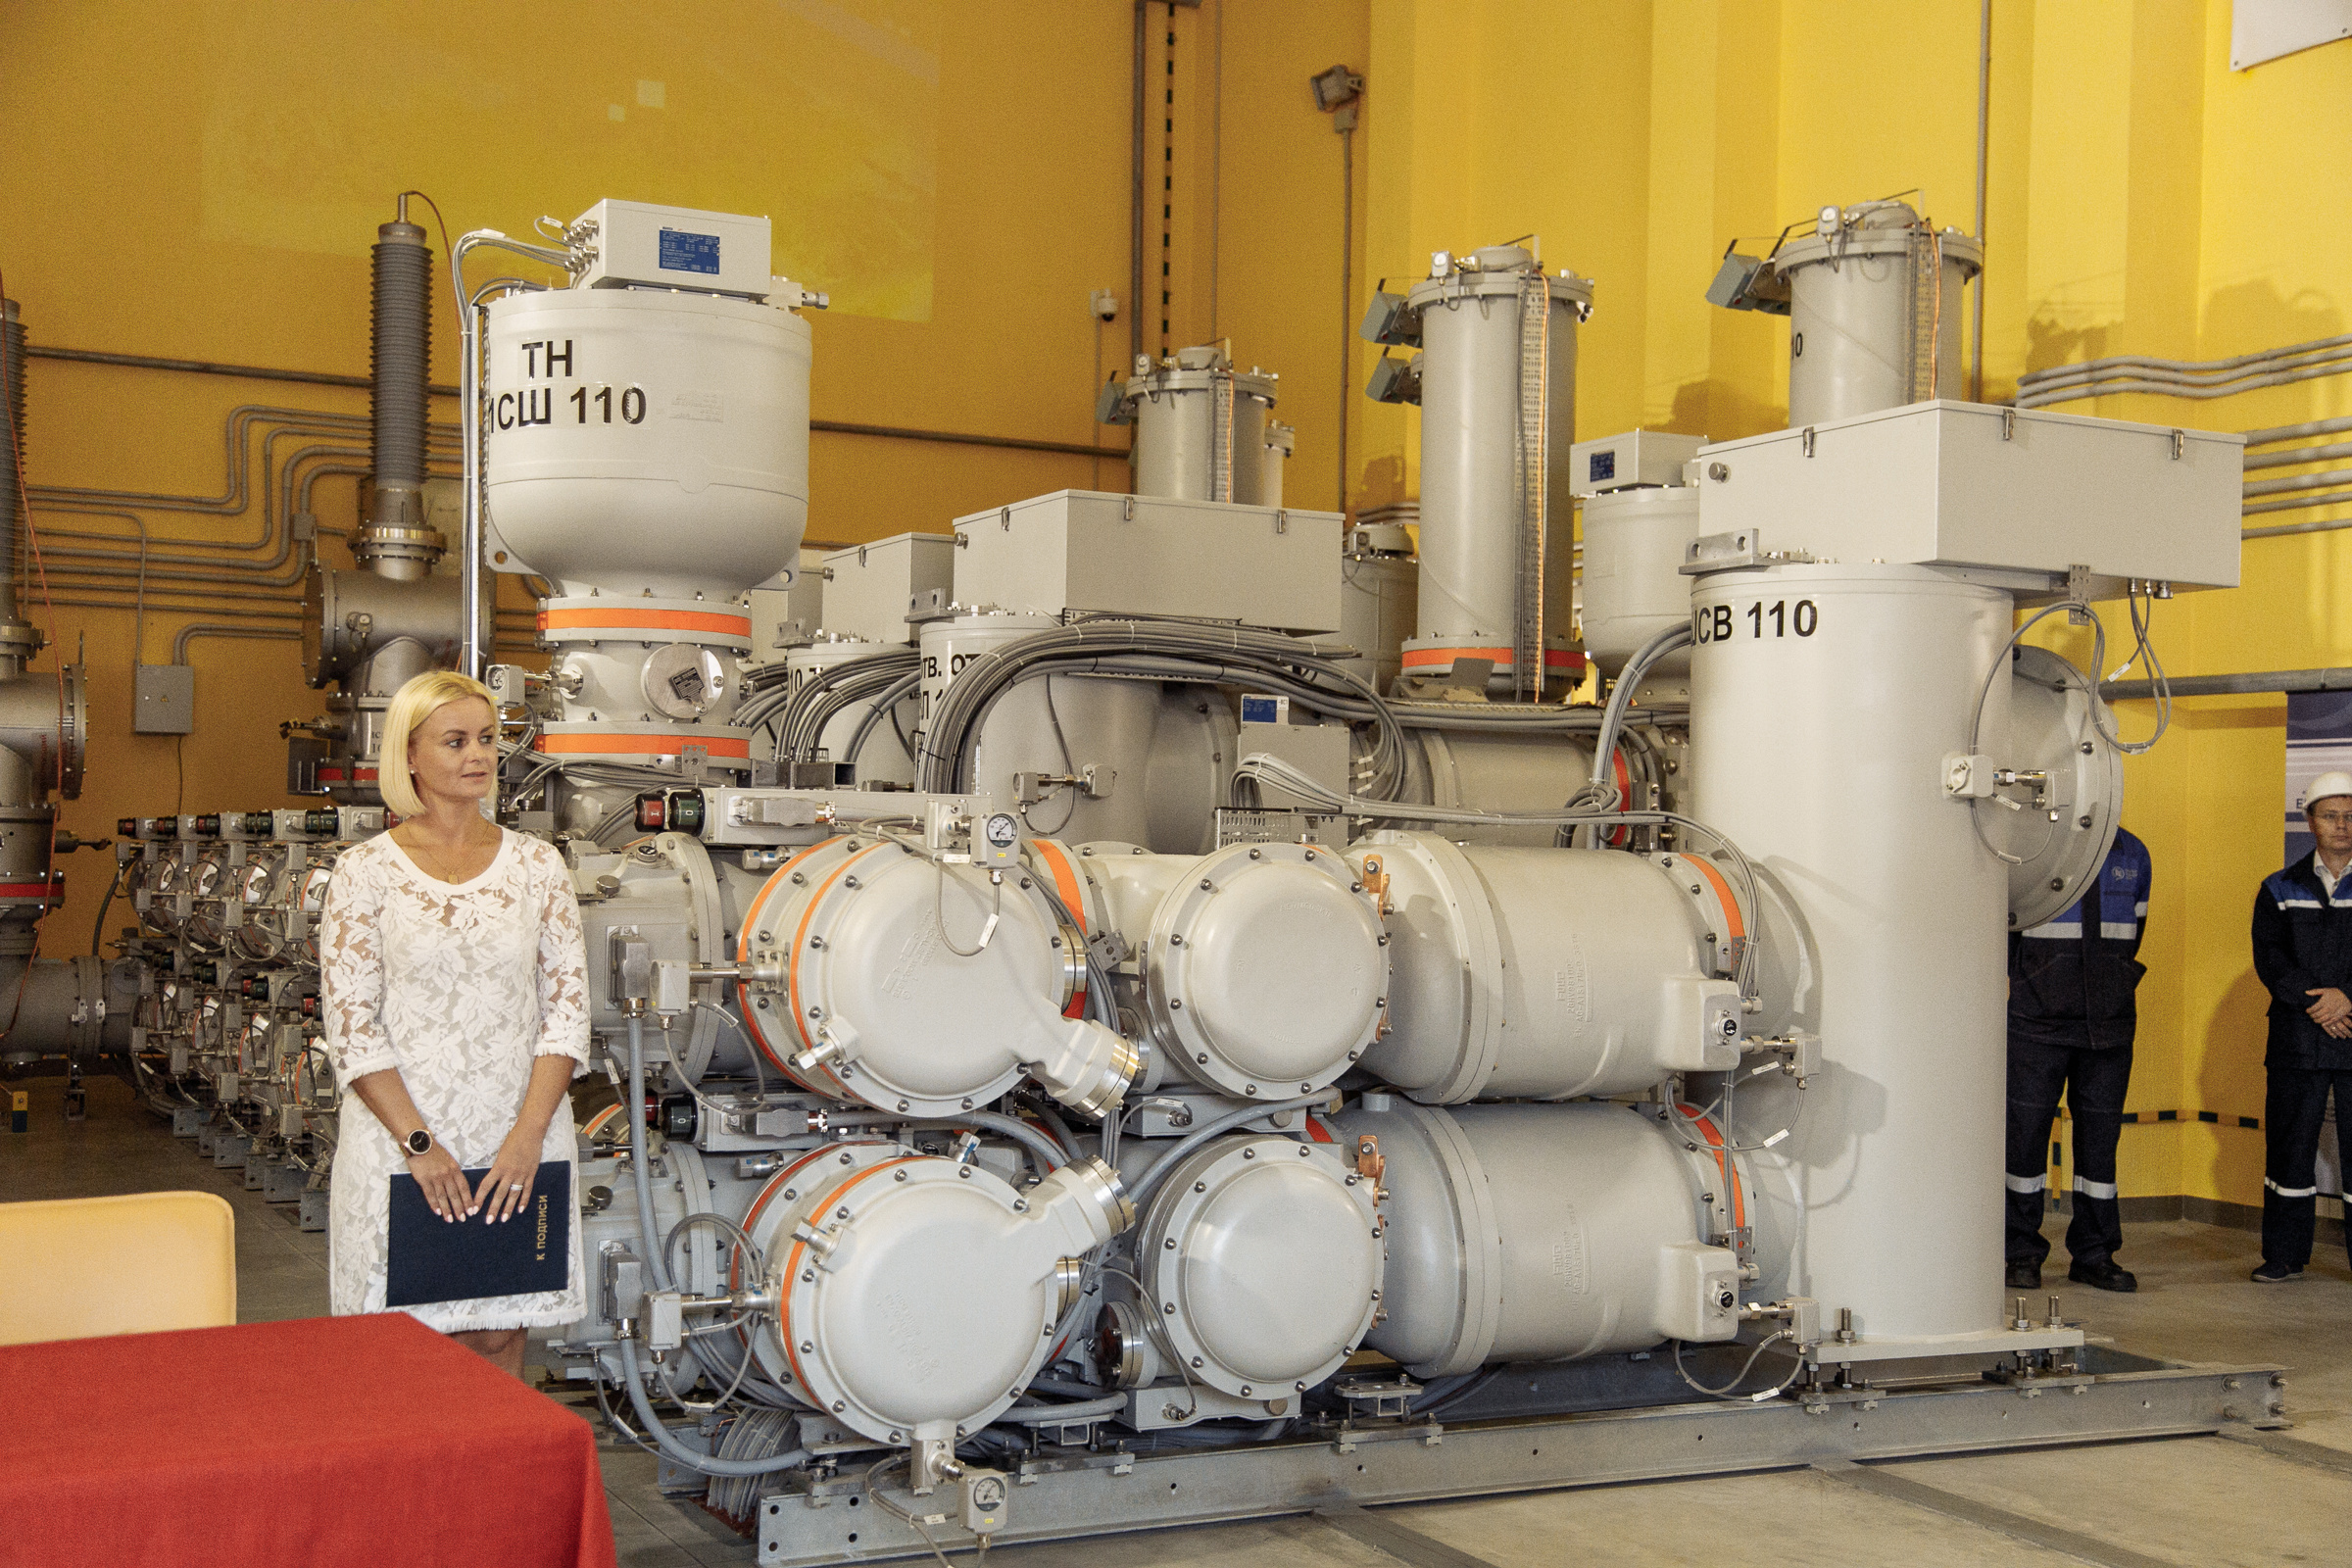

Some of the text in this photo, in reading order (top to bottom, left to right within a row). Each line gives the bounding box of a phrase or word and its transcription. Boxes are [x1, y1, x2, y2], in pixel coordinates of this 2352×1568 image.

[521, 339, 573, 379] ТН
[569, 386, 647, 425] 110
[1747, 599, 1818, 639] 110
[536, 1195, 548, 1261] К ПОДПИСИ
